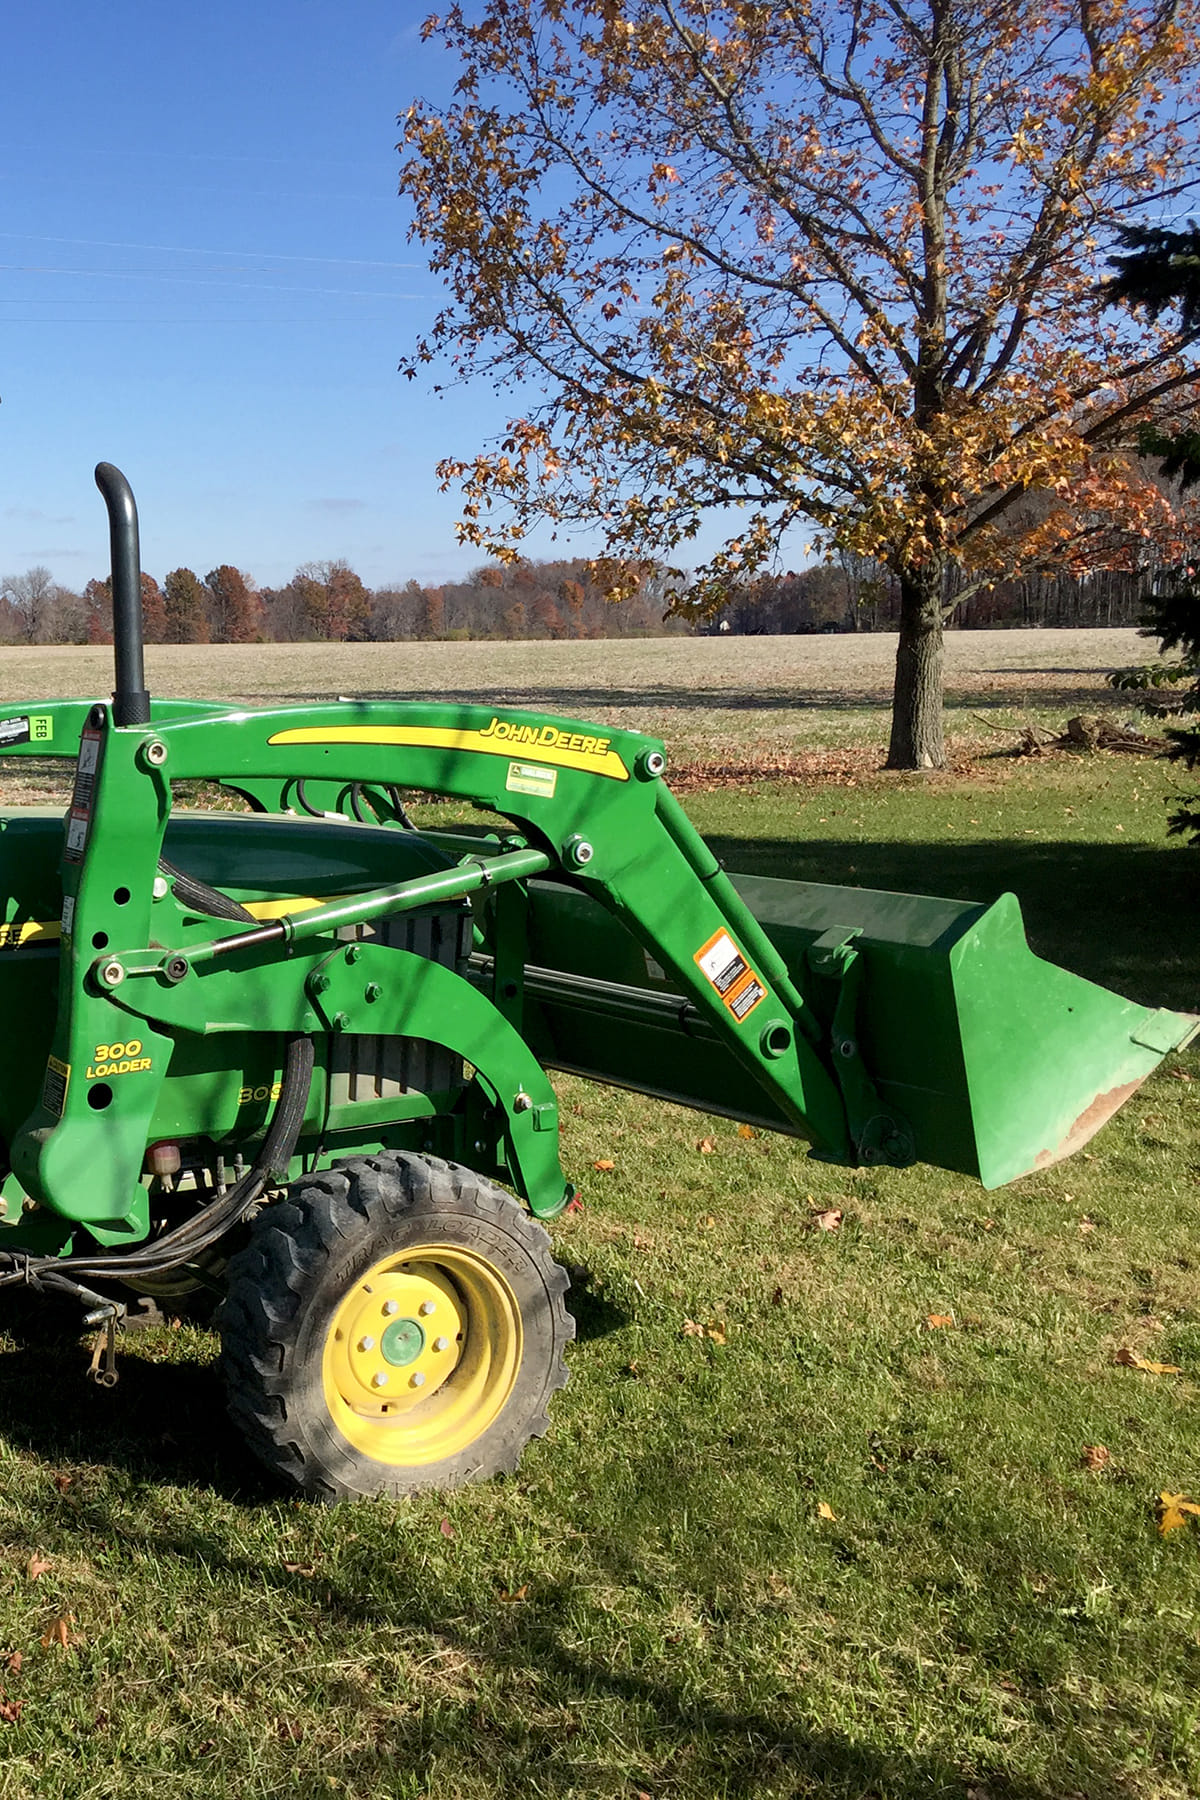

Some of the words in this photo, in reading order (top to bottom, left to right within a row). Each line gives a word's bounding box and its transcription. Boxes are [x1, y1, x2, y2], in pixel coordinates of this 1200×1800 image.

[35, 719, 47, 738] FEB
[479, 718, 538, 745] JOHN
[537, 726, 611, 755] DEERE
[94, 1039, 142, 1062] 300
[85, 1057, 152, 1080] LOADER
[424, 1218, 530, 1273] LOADER
